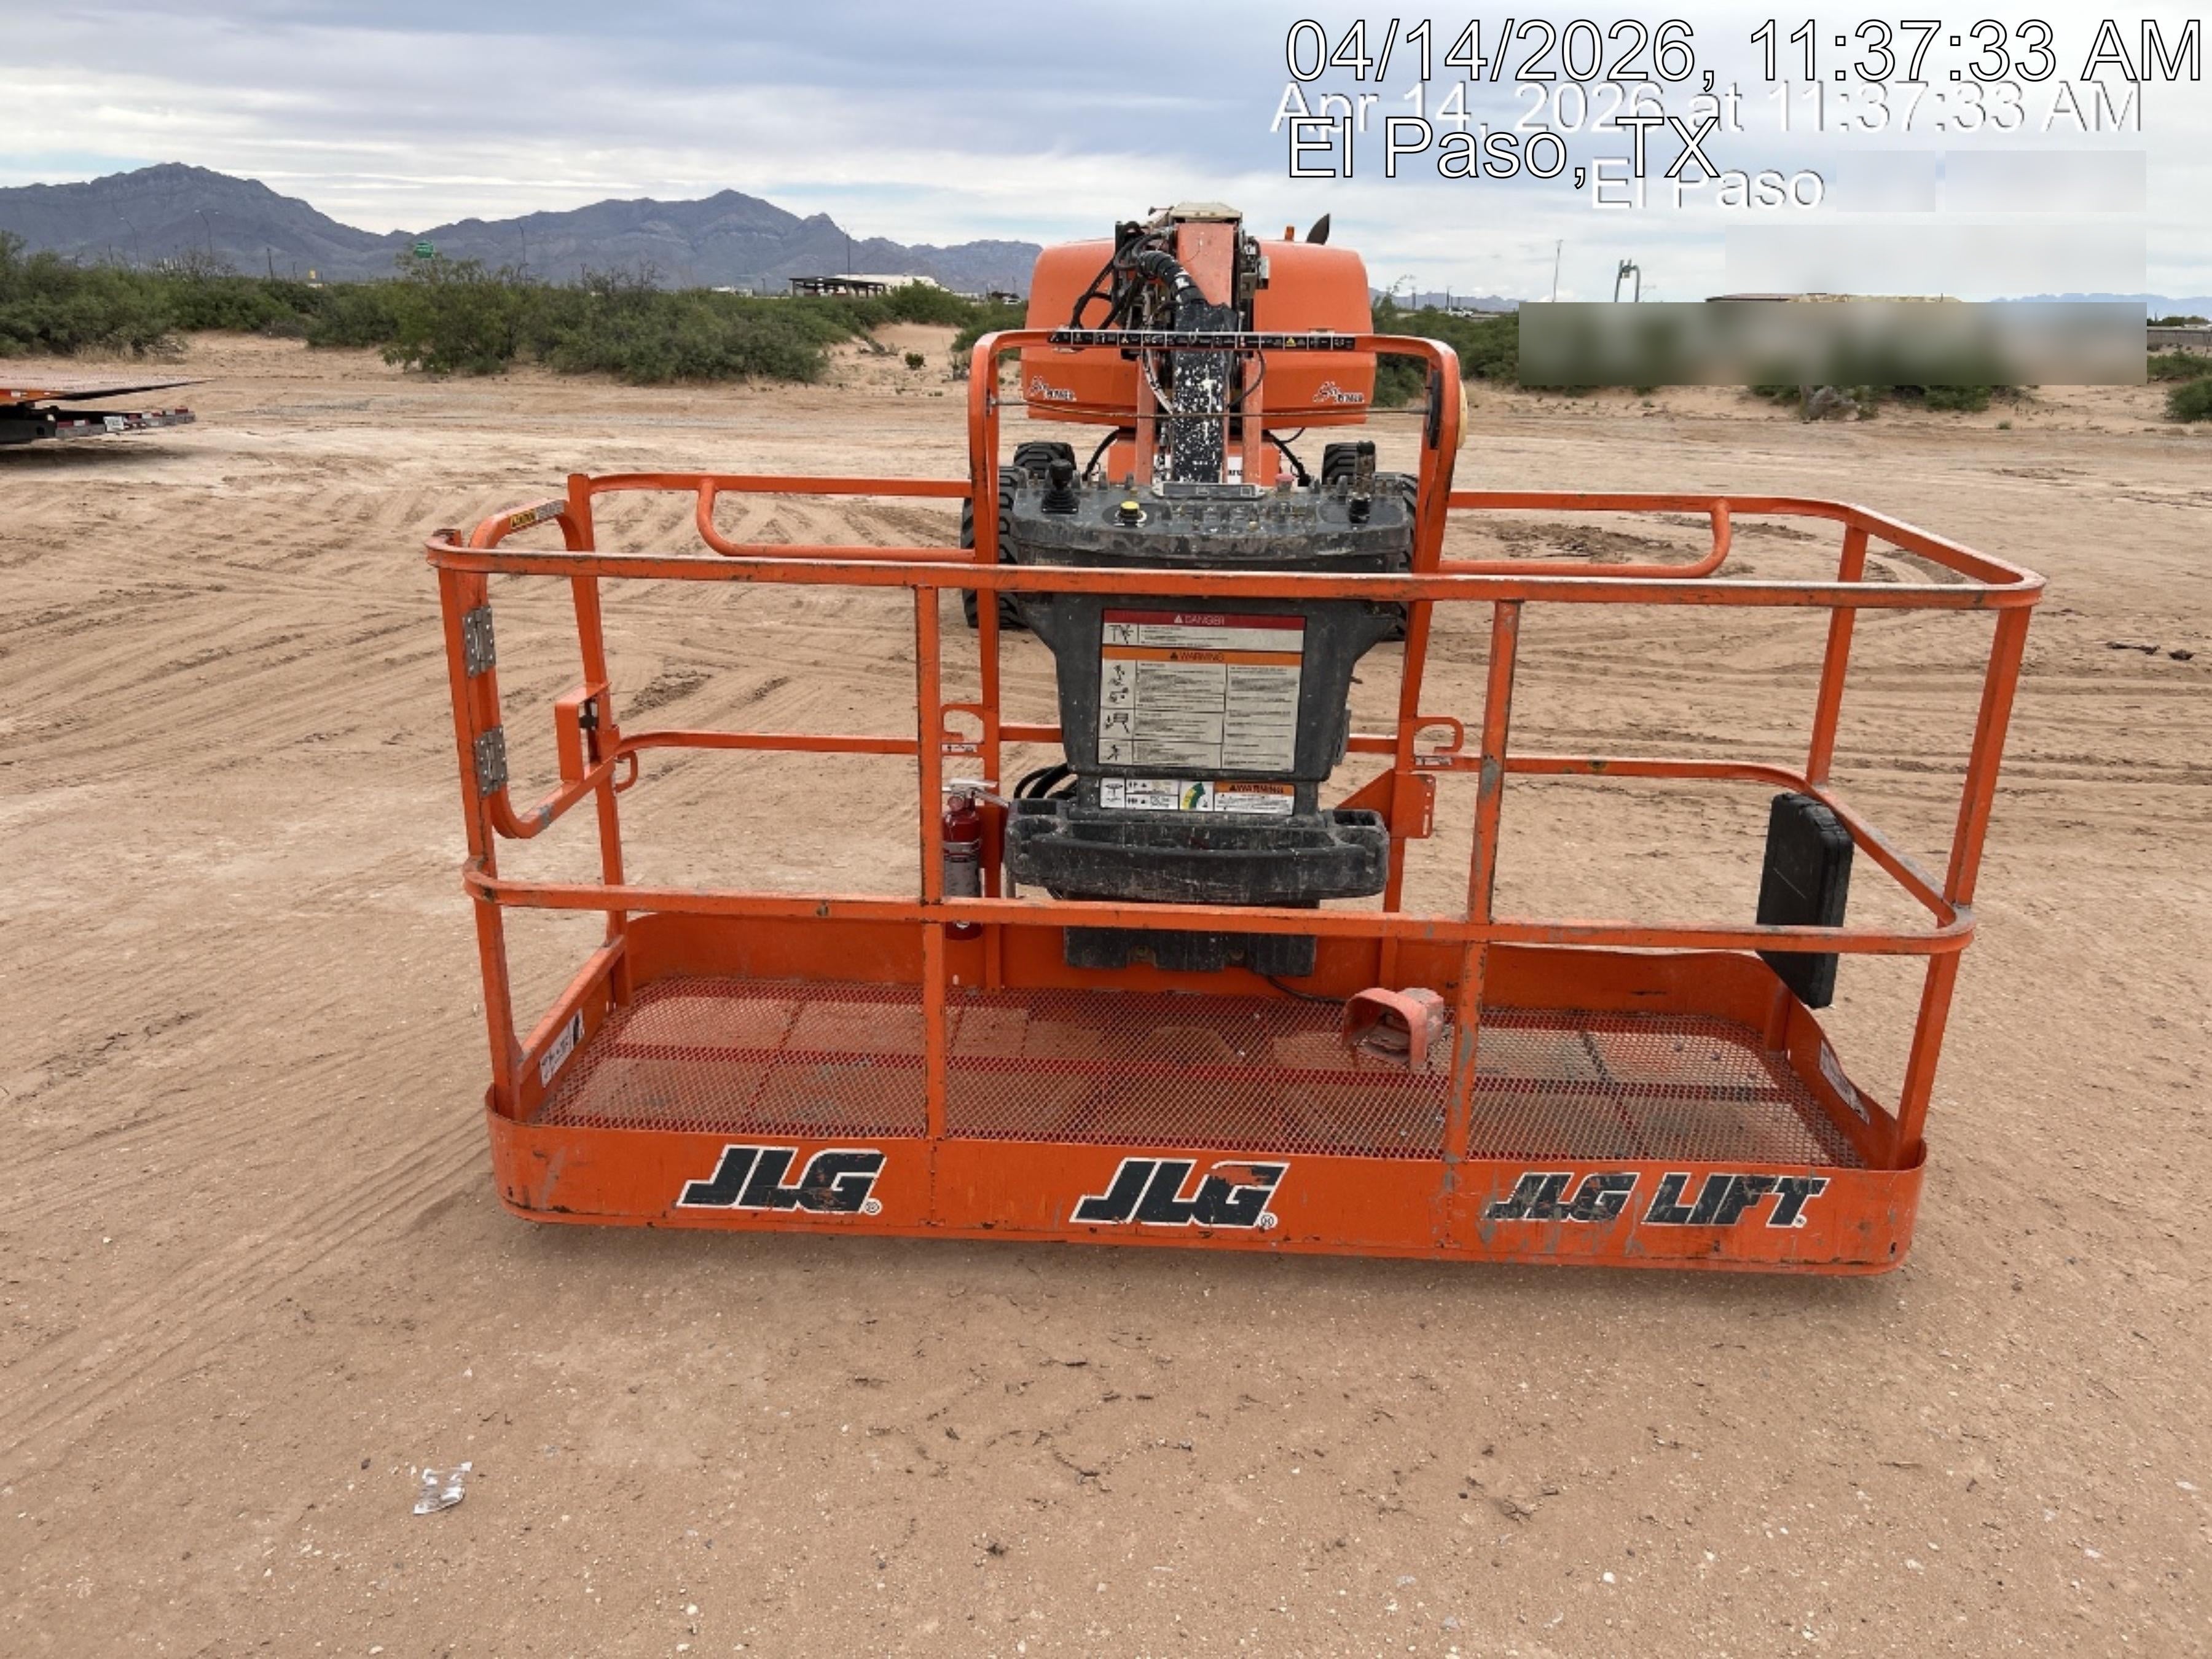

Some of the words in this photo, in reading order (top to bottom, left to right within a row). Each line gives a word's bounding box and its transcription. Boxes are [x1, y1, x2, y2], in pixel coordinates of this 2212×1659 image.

[1184, 615, 1225, 626] DANGER
[1180, 652, 1225, 662] WARNING
[1481, 1171, 1640, 1225] JLG
